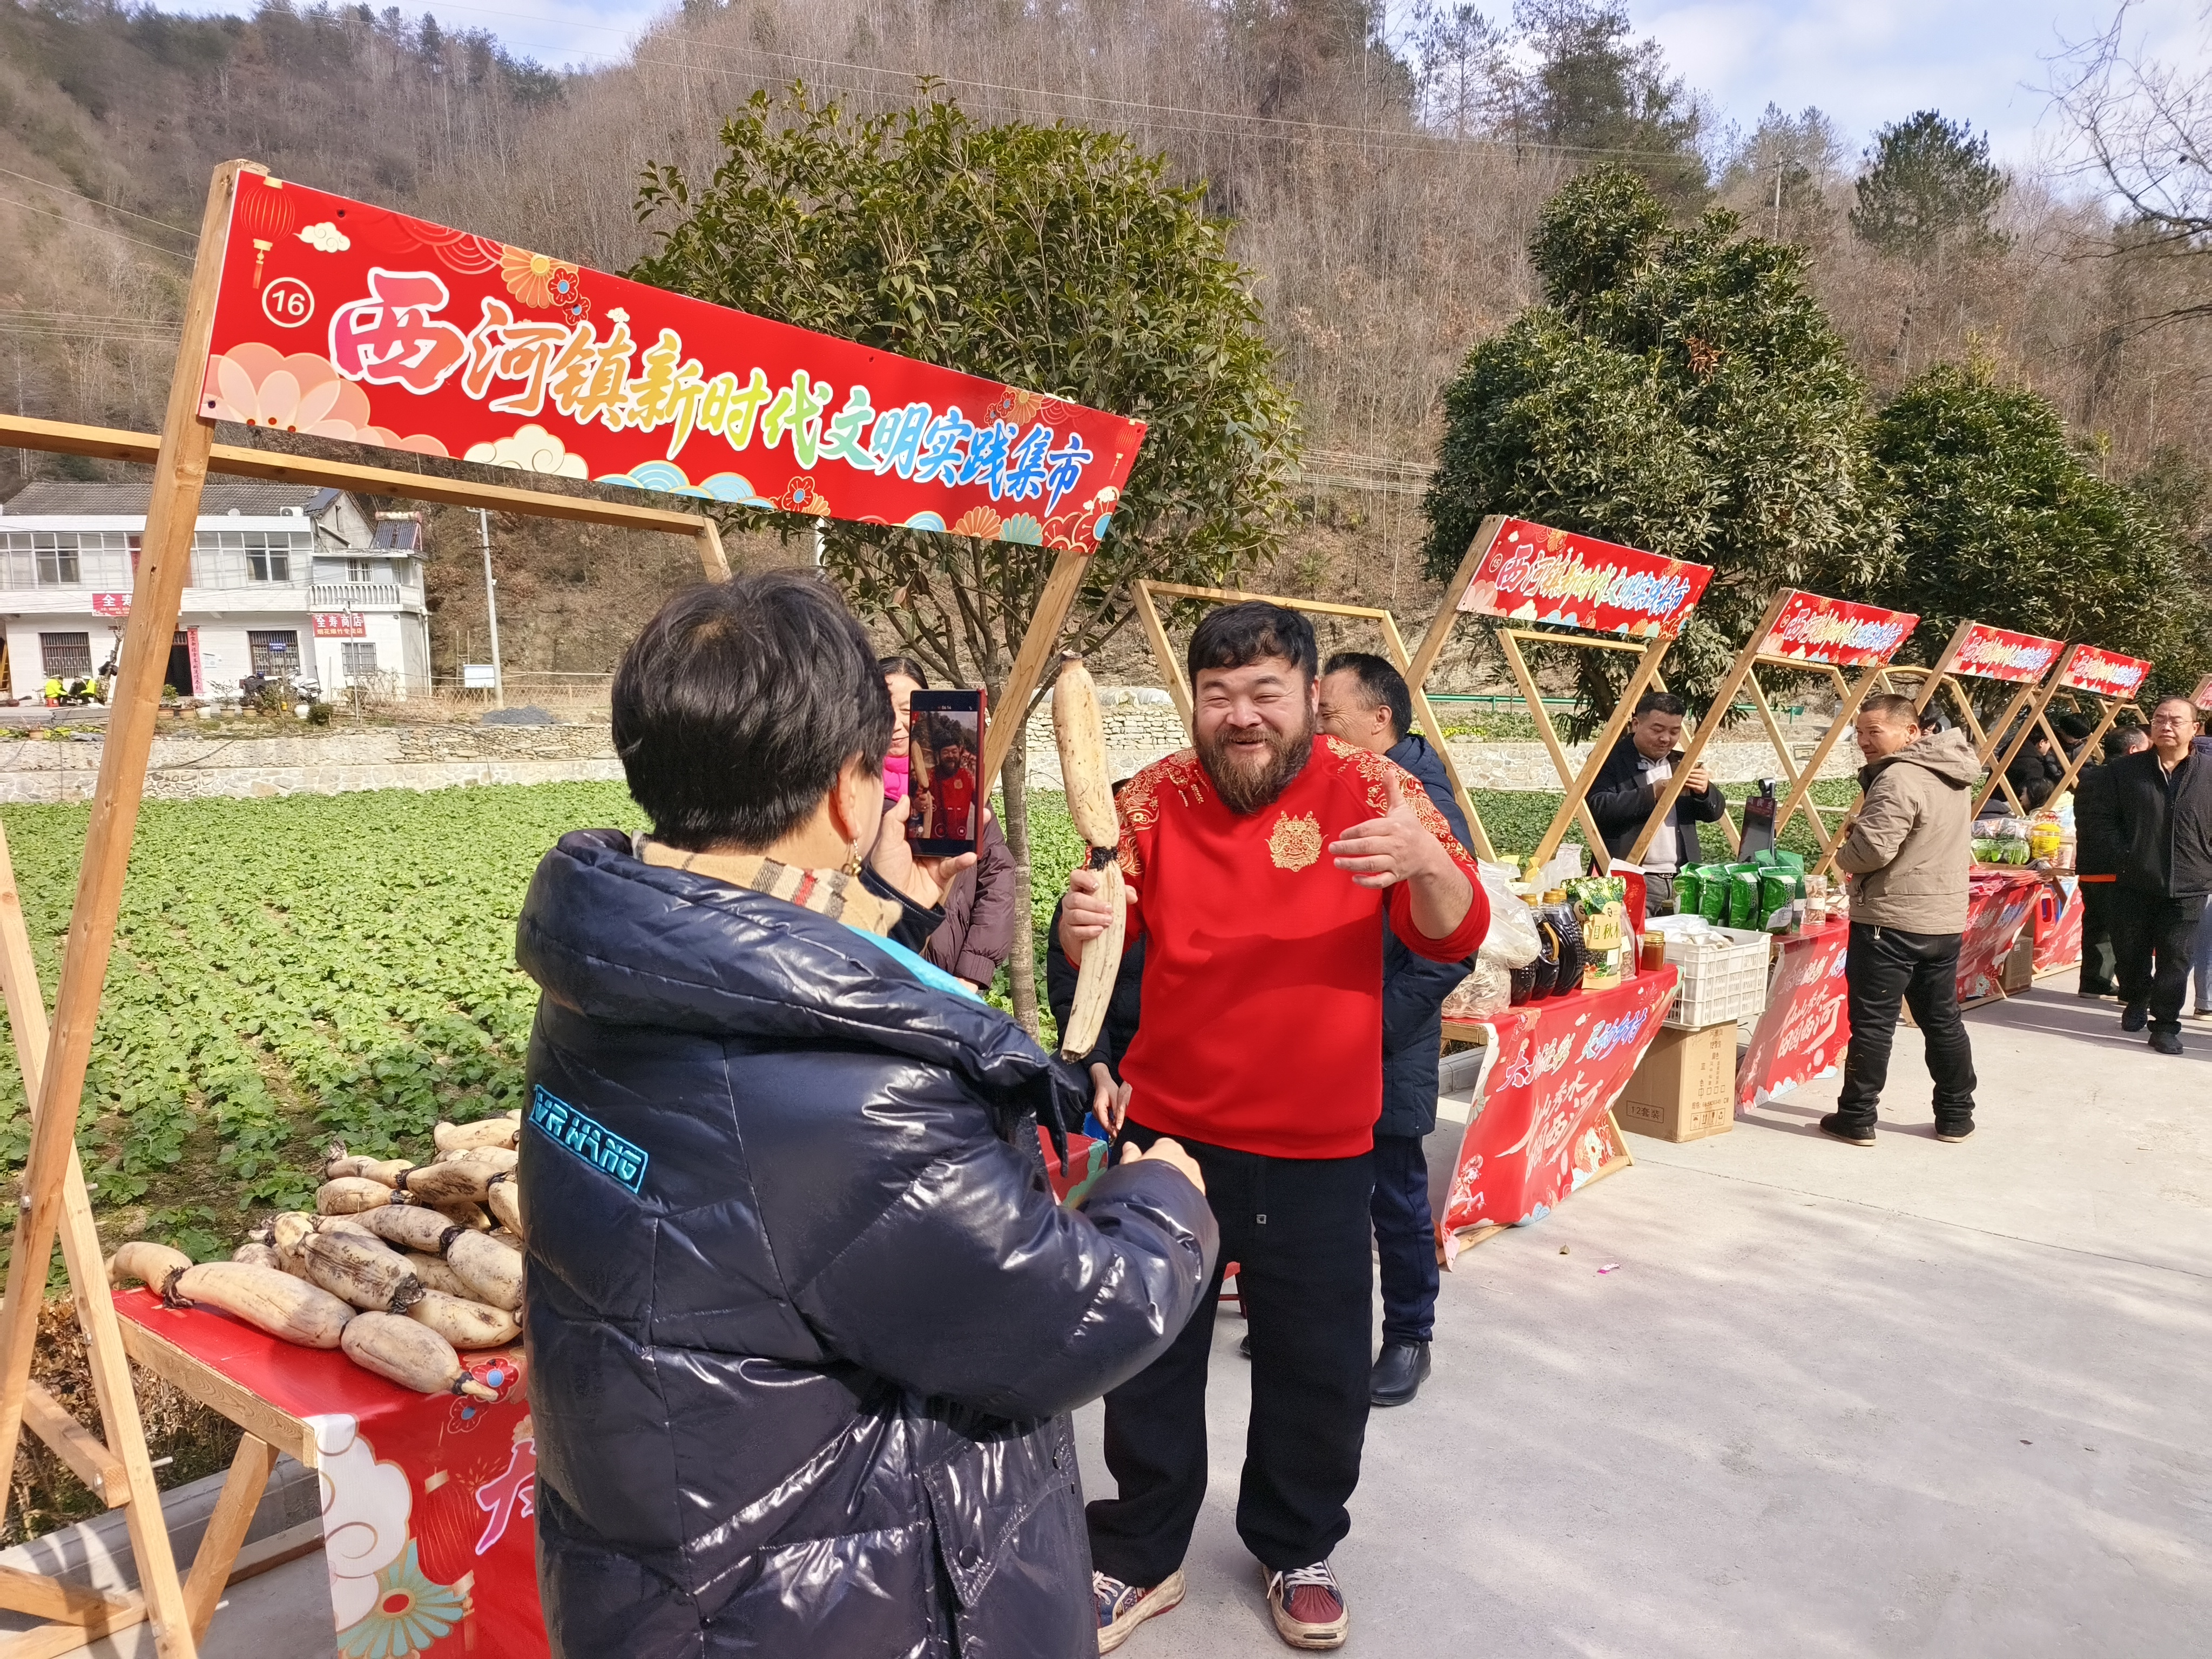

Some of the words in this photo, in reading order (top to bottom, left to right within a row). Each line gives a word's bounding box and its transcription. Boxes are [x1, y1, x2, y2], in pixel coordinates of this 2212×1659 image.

[271, 289, 306, 316] 16
[328, 267, 1093, 517] 西河镇新时代文明实践集市
[1495, 544, 1690, 623] 西河镇新时代文明实践集市
[316, 615, 363, 628] 全寿商店
[1631, 1106, 1660, 1121] 12套装
